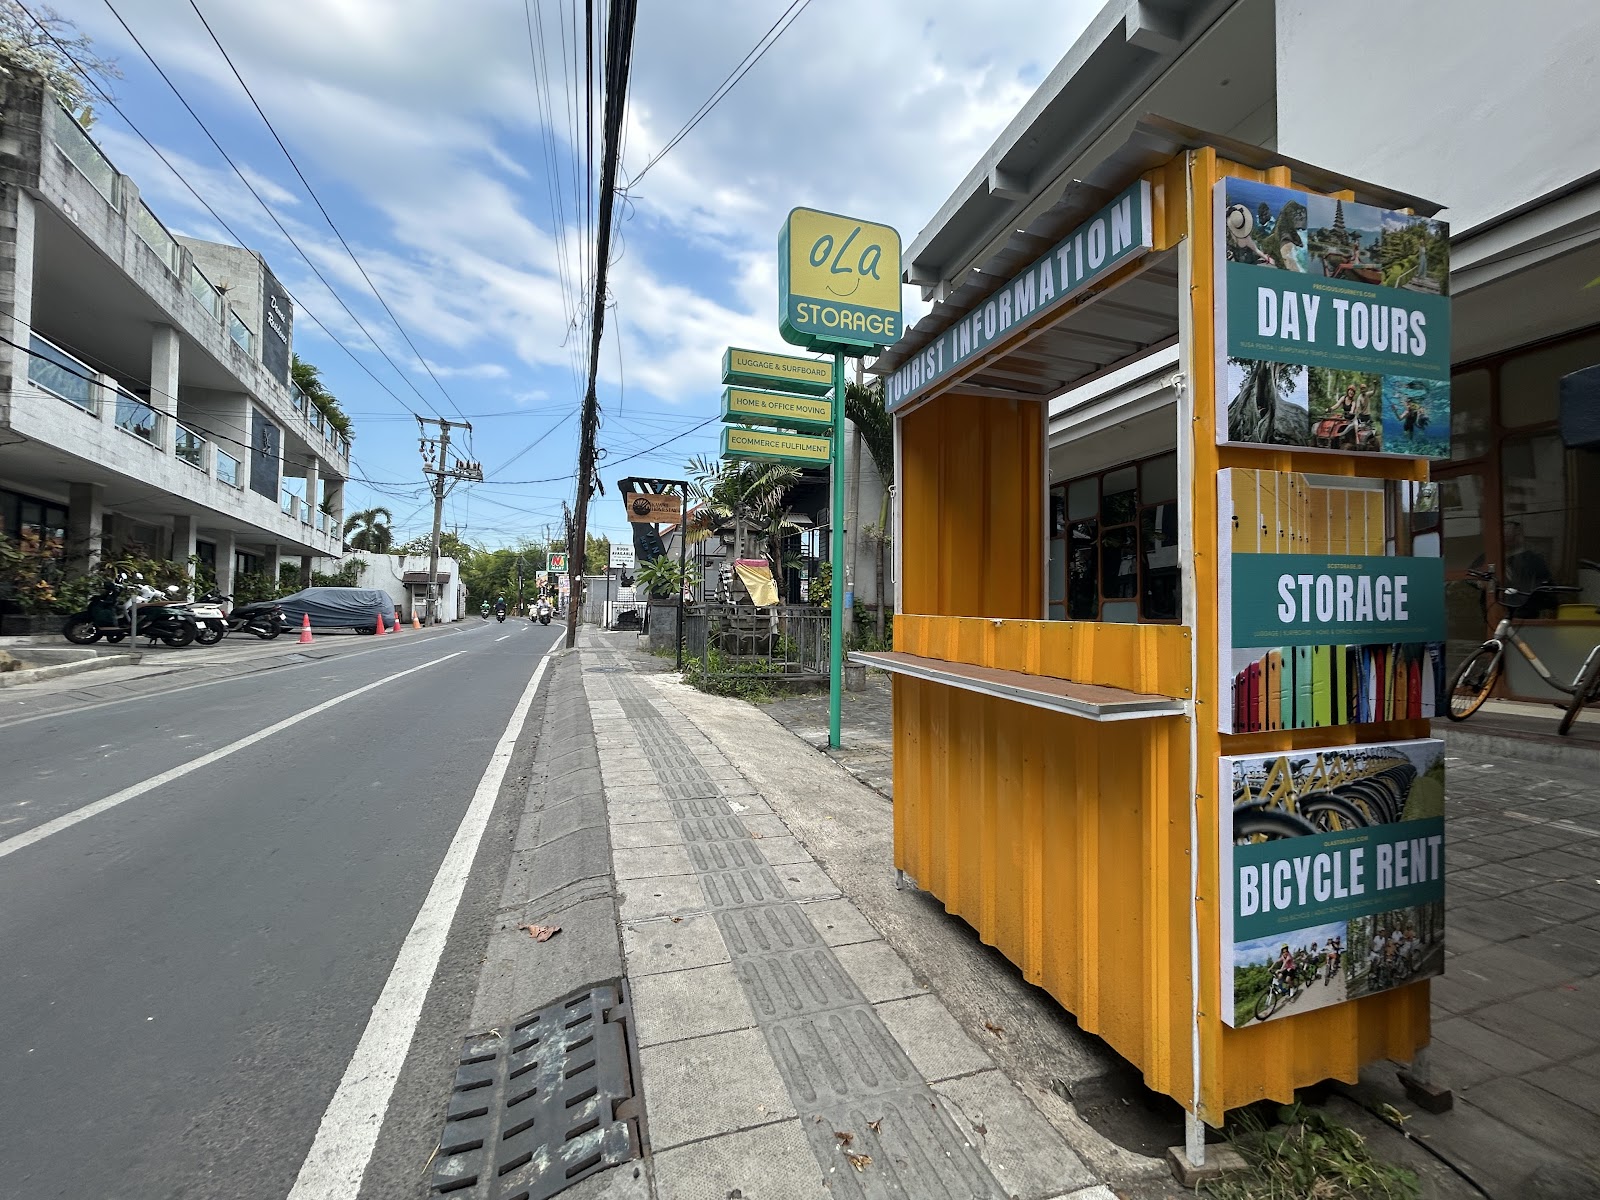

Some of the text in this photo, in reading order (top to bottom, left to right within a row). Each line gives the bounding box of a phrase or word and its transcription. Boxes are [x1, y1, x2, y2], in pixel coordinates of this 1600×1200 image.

[797, 302, 895, 337] STORAGE
[887, 194, 1132, 406] TOURIST INFORMATION
[1257, 287, 1427, 357] DAY TOURS
[737, 357, 827, 377] LUGGAGE & SURFBOARD
[736, 397, 826, 415] HOME & OFFICE MOVING
[731, 436, 827, 453] ECOMMERCE FULFILMENT
[1278, 573, 1409, 624] STORAGE
[1240, 835, 1442, 917] BICYCLE RENT
